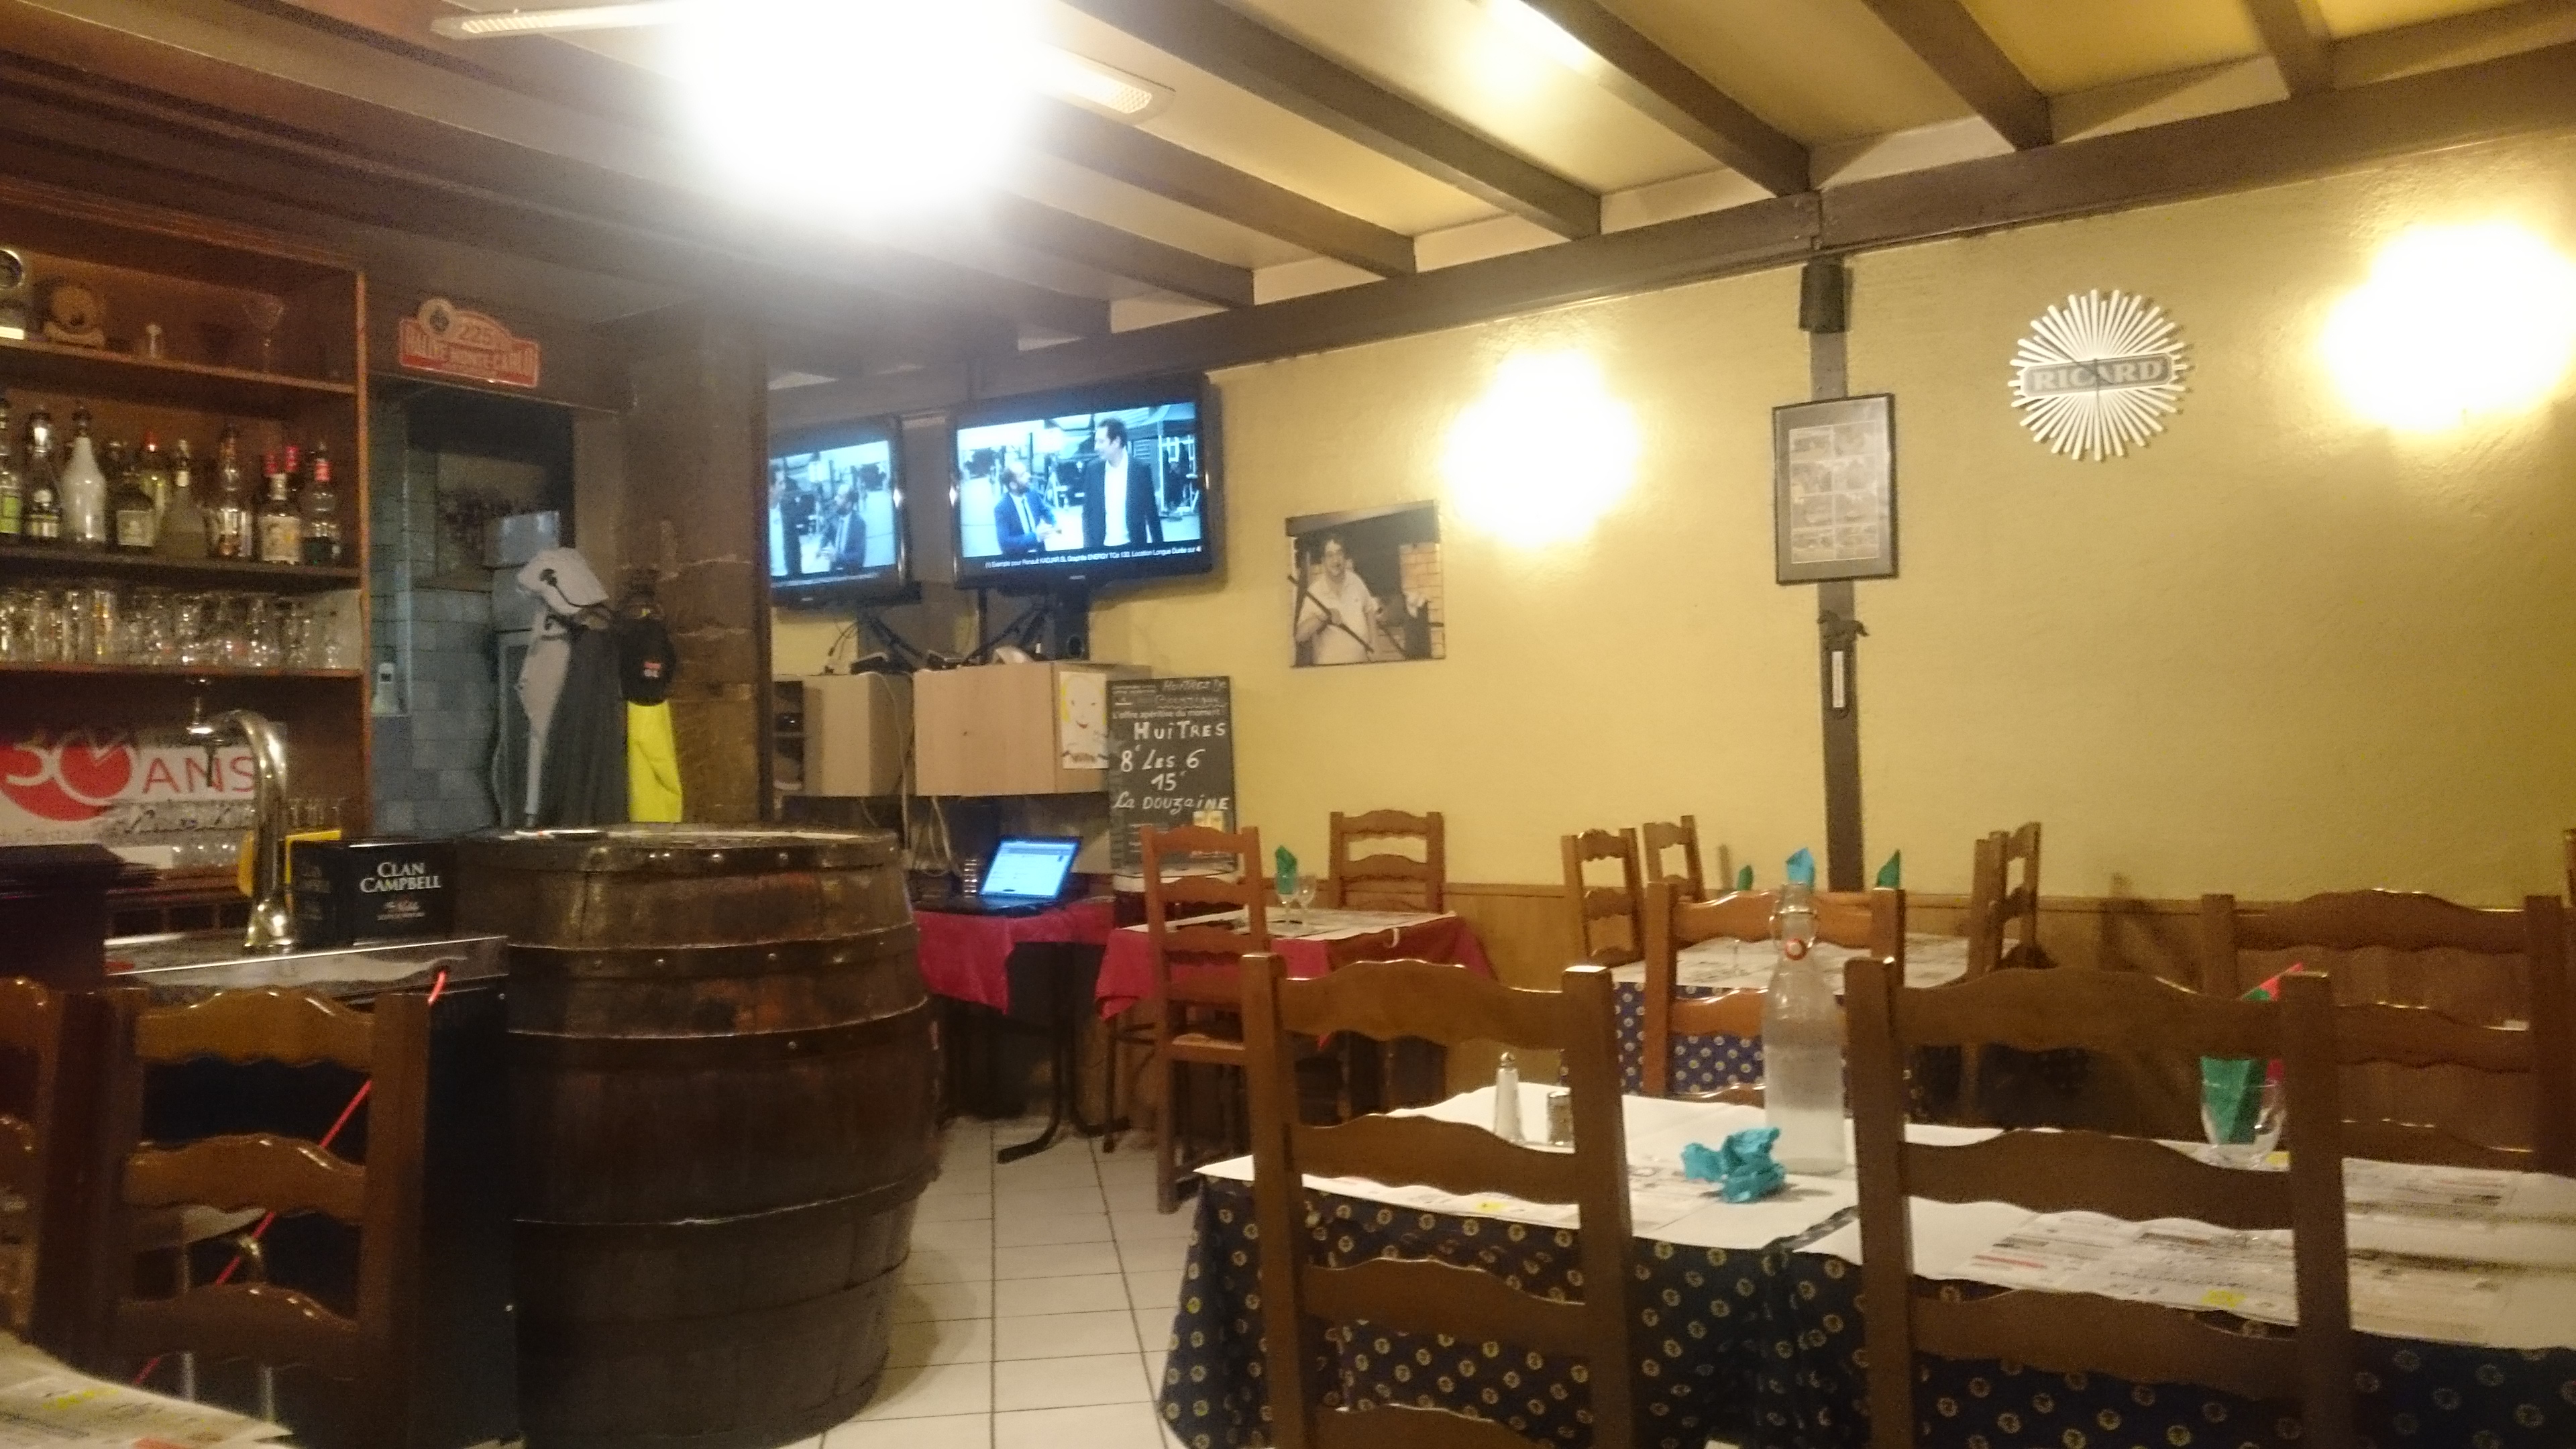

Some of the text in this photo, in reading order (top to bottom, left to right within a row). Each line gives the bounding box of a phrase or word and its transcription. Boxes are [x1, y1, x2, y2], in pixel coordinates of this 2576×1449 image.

[2033, 362, 2163, 391] RICARD
[1186, 749, 1206, 769] 6
[142, 755, 256, 794] ANS
[377, 861, 425, 878] CLAN
[360, 875, 442, 894] CAMPBELL
